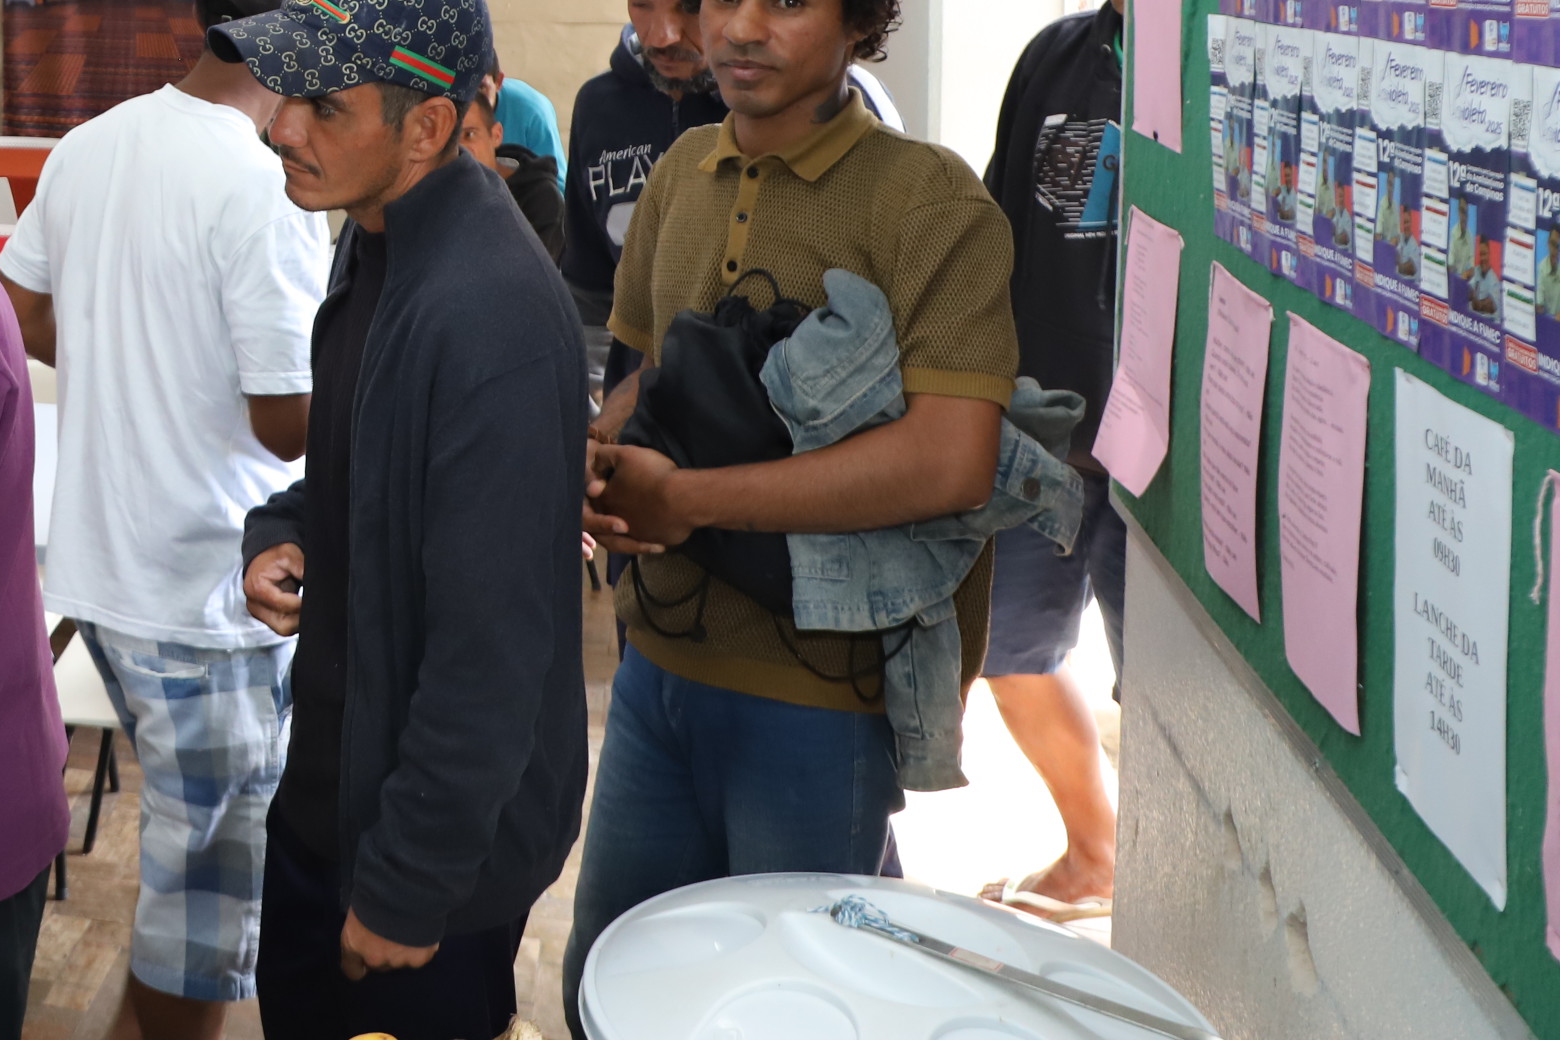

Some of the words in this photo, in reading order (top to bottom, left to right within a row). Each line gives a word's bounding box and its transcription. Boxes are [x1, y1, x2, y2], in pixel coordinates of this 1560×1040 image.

[1517, 3, 1549, 16] GRATUITOS
[1390, 58, 1424, 82] Fevereiro
[1465, 72, 1508, 99] Fevereiro
[599, 143, 652, 164] American
[1473, 184, 1504, 202] Campinas
[1479, 320, 1501, 344] FUMEC
[1425, 428, 1451, 464] CAFÉ
[1454, 445, 1473, 476] DA
[1425, 462, 1467, 509] MANHÃ
[1428, 499, 1448, 531] ATÉ
[1449, 509, 1464, 543] ÀS
[1433, 536, 1461, 577] 09H30
[1413, 592, 1459, 648] LANCHE
[1461, 632, 1480, 665] DA
[1427, 636, 1464, 688] TARDE
[1425, 671, 1447, 707] ATÉ
[1448, 687, 1463, 723] ÀS
[1429, 710, 1461, 756] 14H30
